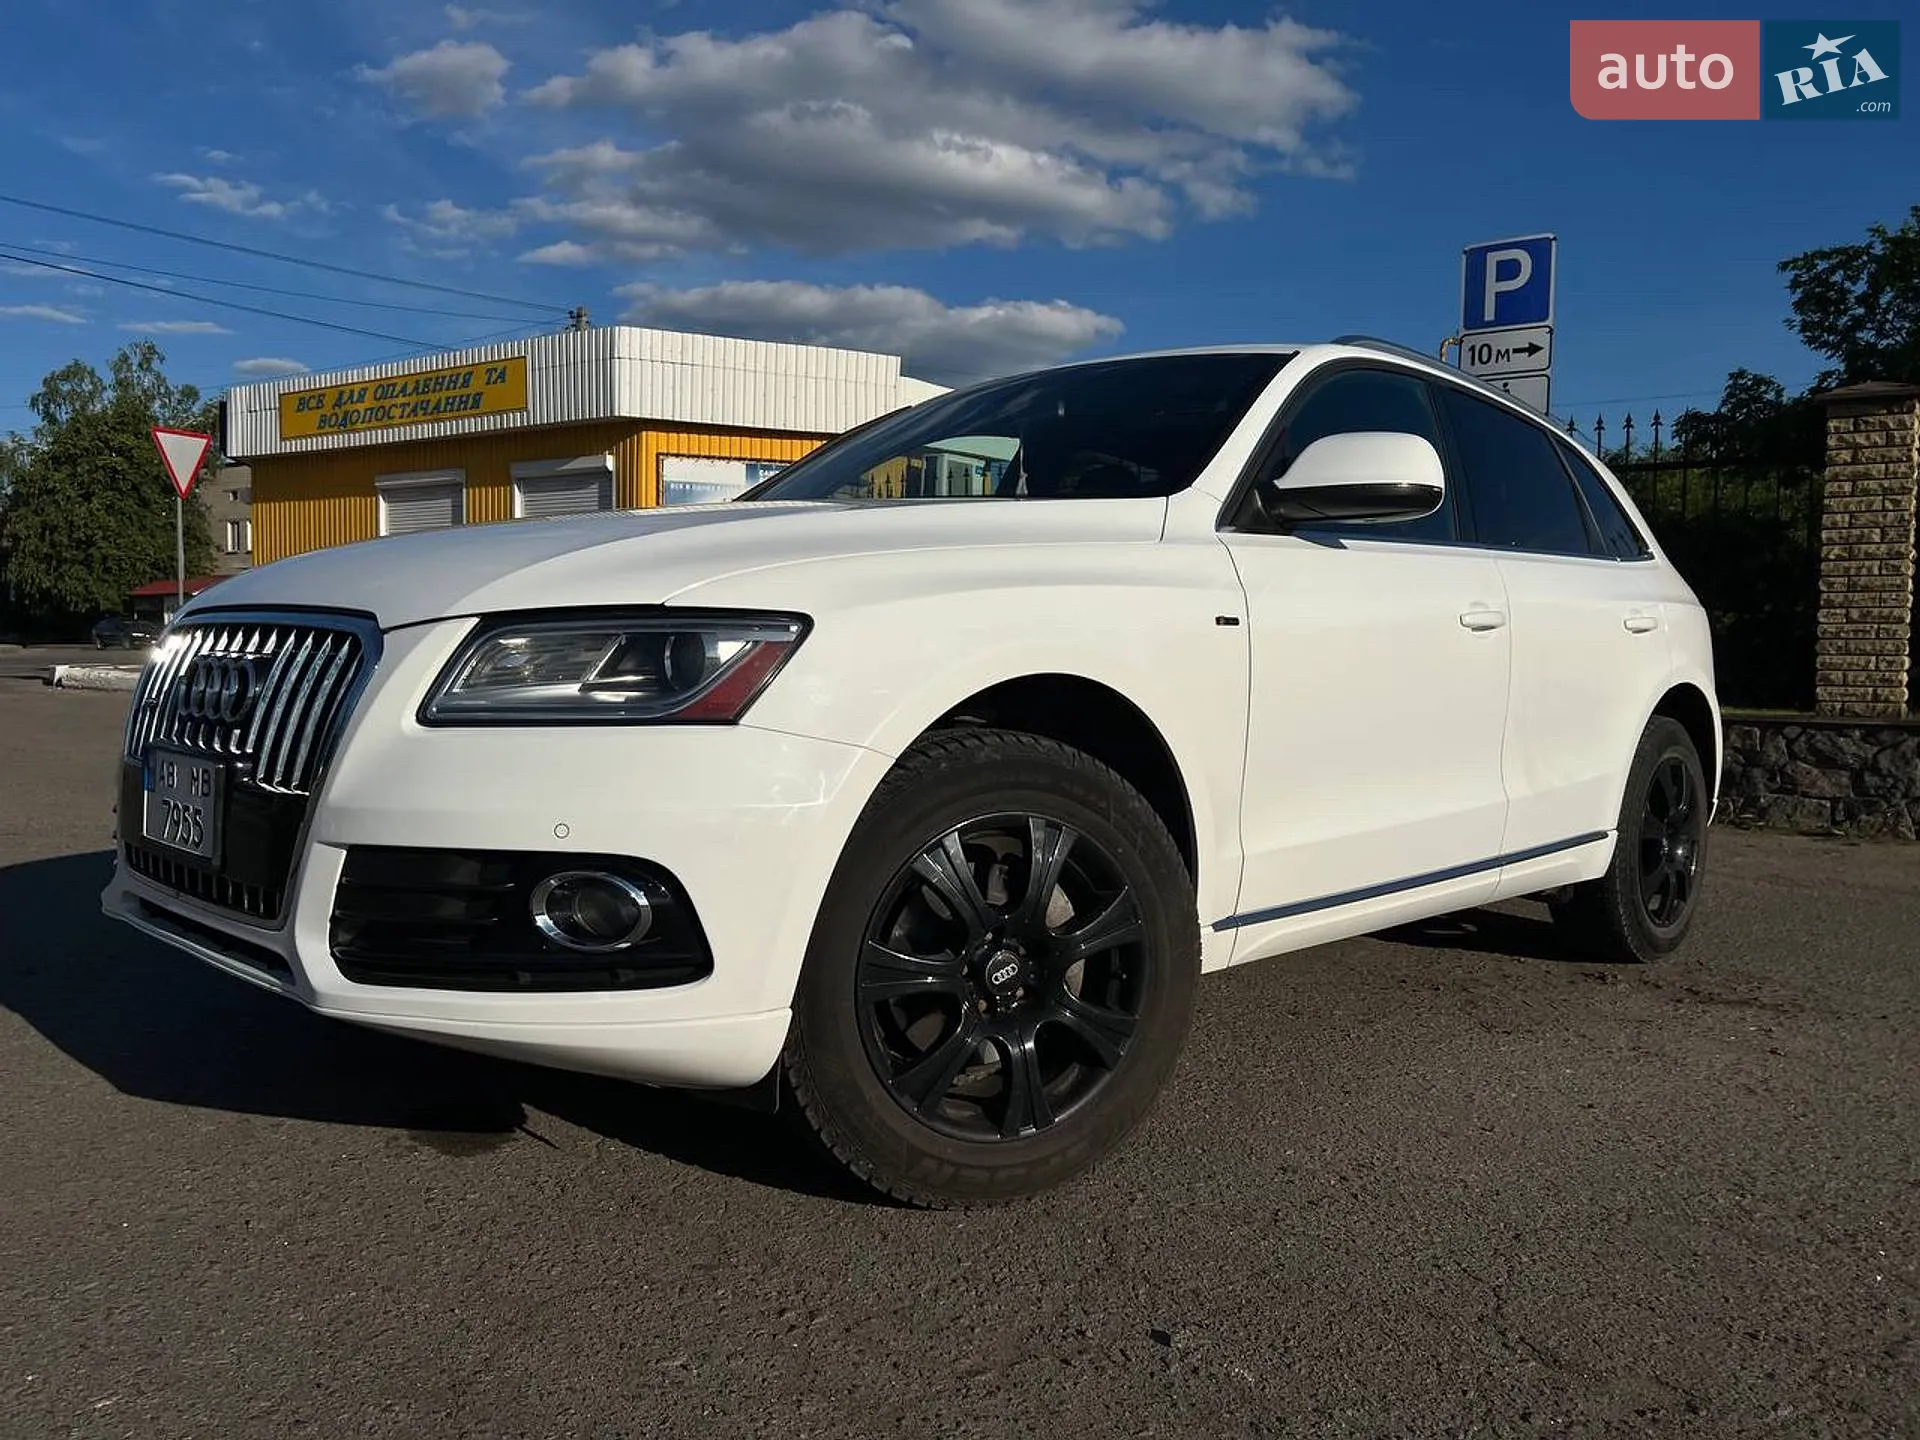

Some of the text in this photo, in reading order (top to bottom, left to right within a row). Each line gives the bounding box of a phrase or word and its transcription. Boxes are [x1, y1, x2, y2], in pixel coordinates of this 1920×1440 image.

[1484, 249, 1533, 321] P
[295, 366, 507, 413] ВСЕ ДЛЯ ОПАЛЕННЯ ТА
[317, 391, 484, 430] ВОДОПОСТАЧАННЯ
